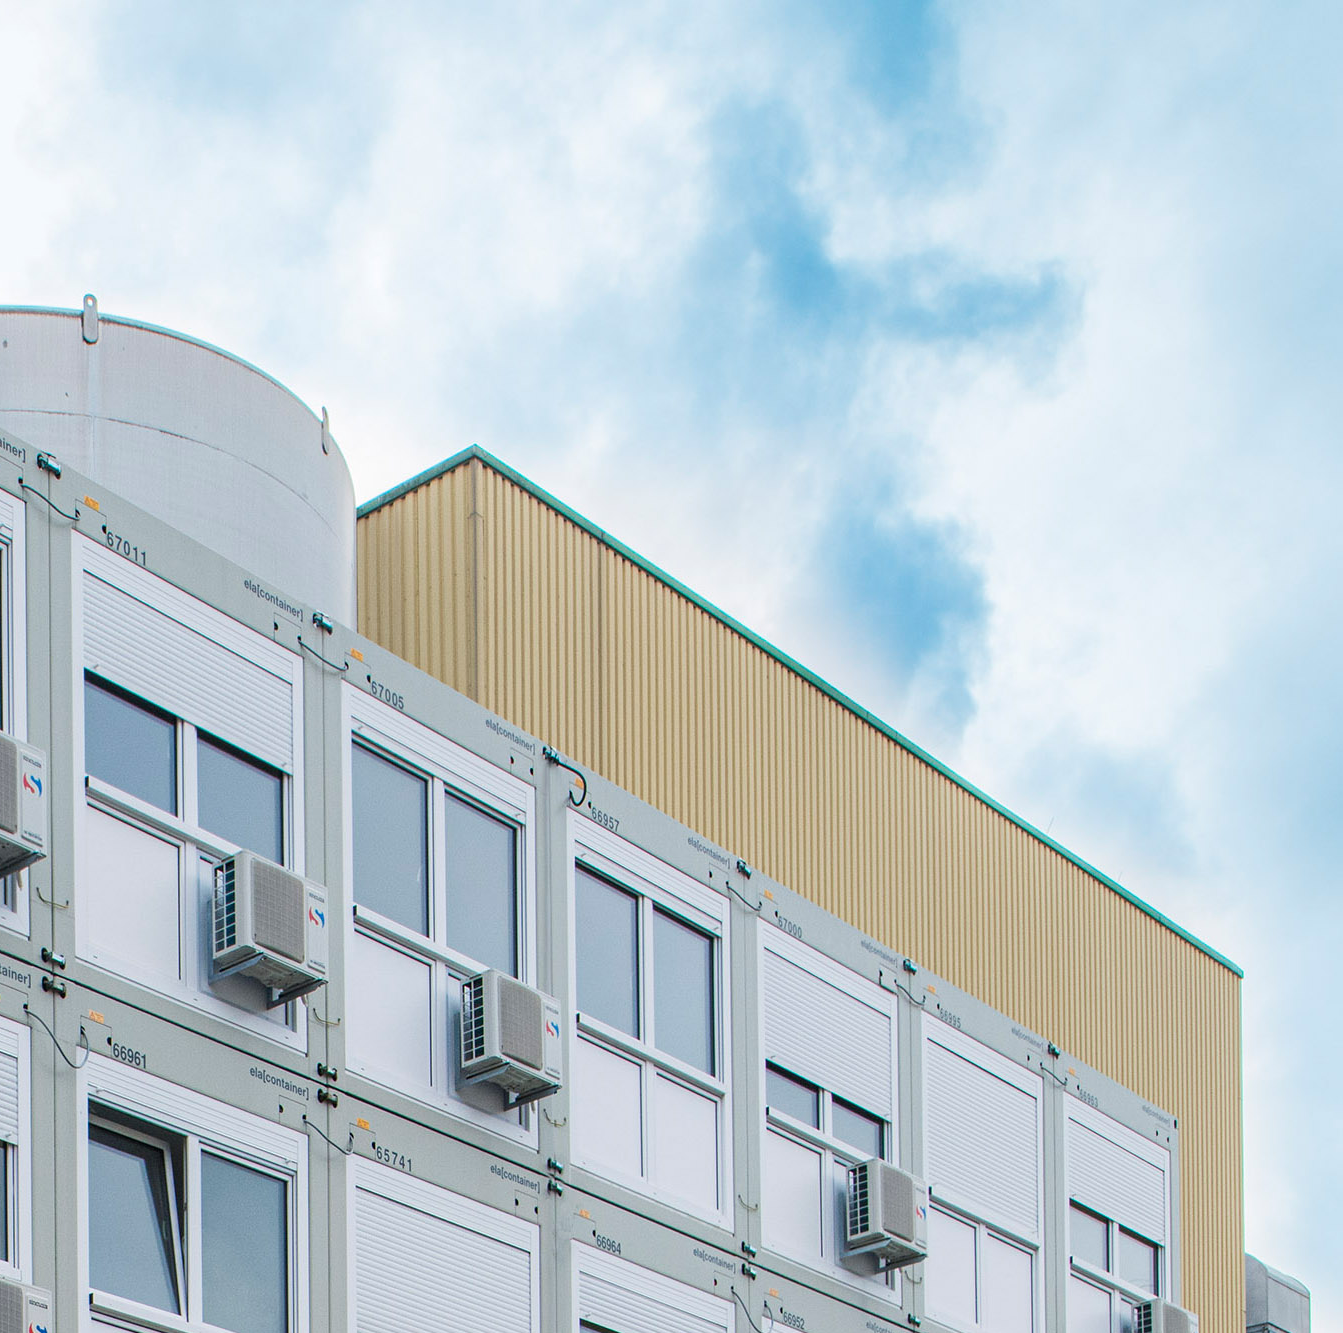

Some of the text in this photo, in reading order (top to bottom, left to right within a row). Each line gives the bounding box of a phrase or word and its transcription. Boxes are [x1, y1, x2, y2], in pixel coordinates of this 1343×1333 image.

[106, 531, 147, 566] 67011
[244, 578, 304, 622] ela[container]
[371, 681, 404, 710] 67005
[485, 718, 536, 755] ela[container]
[591, 807, 620, 832] 66957
[688, 836, 731, 869] ela[container]
[112, 1043, 147, 1069] 66961
[249, 1067, 309, 1101] ela[container]
[376, 1146, 413, 1172] 65741
[490, 1164, 540, 1194] ela[container]
[596, 1235, 622, 1255] 66964
[693, 1247, 736, 1274] ela[container]
[783, 1310, 805, 1330] 66952
